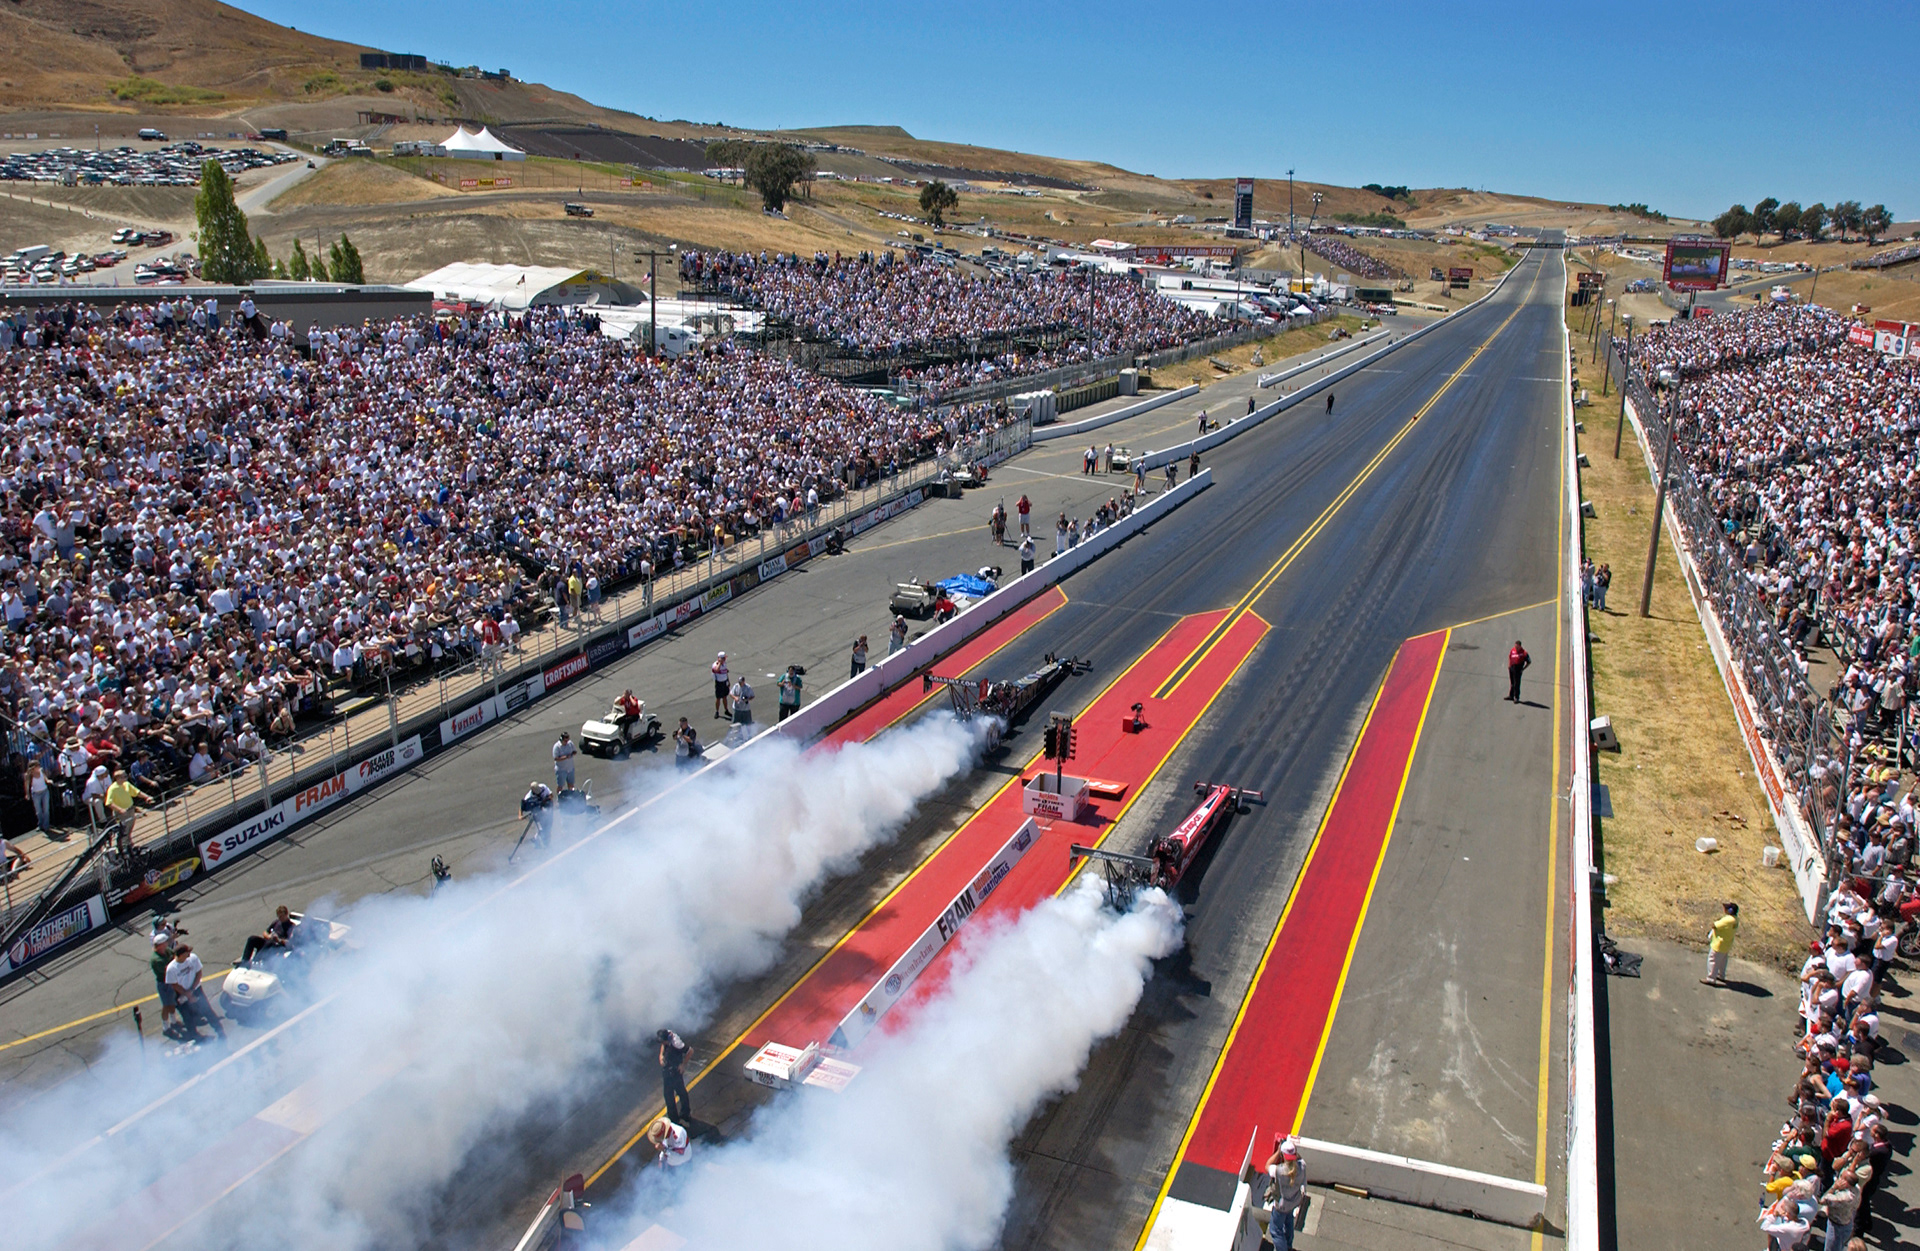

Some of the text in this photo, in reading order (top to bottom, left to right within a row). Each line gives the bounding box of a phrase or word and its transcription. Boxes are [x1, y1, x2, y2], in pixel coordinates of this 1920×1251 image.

[1163, 247, 1186, 255] FRAM
[1211, 247, 1234, 255] FRAM
[675, 602, 691, 617] MSD
[545, 654, 588, 687] CRAFTSMAN
[928, 675, 977, 687] GOARMY.COM
[370, 750, 395, 767] SEALED
[370, 757, 395, 775] POWER
[295, 772, 346, 813] FRAM
[1037, 803, 1059, 812] FRAM
[224, 811, 285, 851] SUZUKI
[982, 862, 1010, 897] NATIONALS
[30, 904, 89, 944] FEATHERLITE
[936, 888, 976, 942] FRAM
[31, 931, 65, 957] TRAILERS
